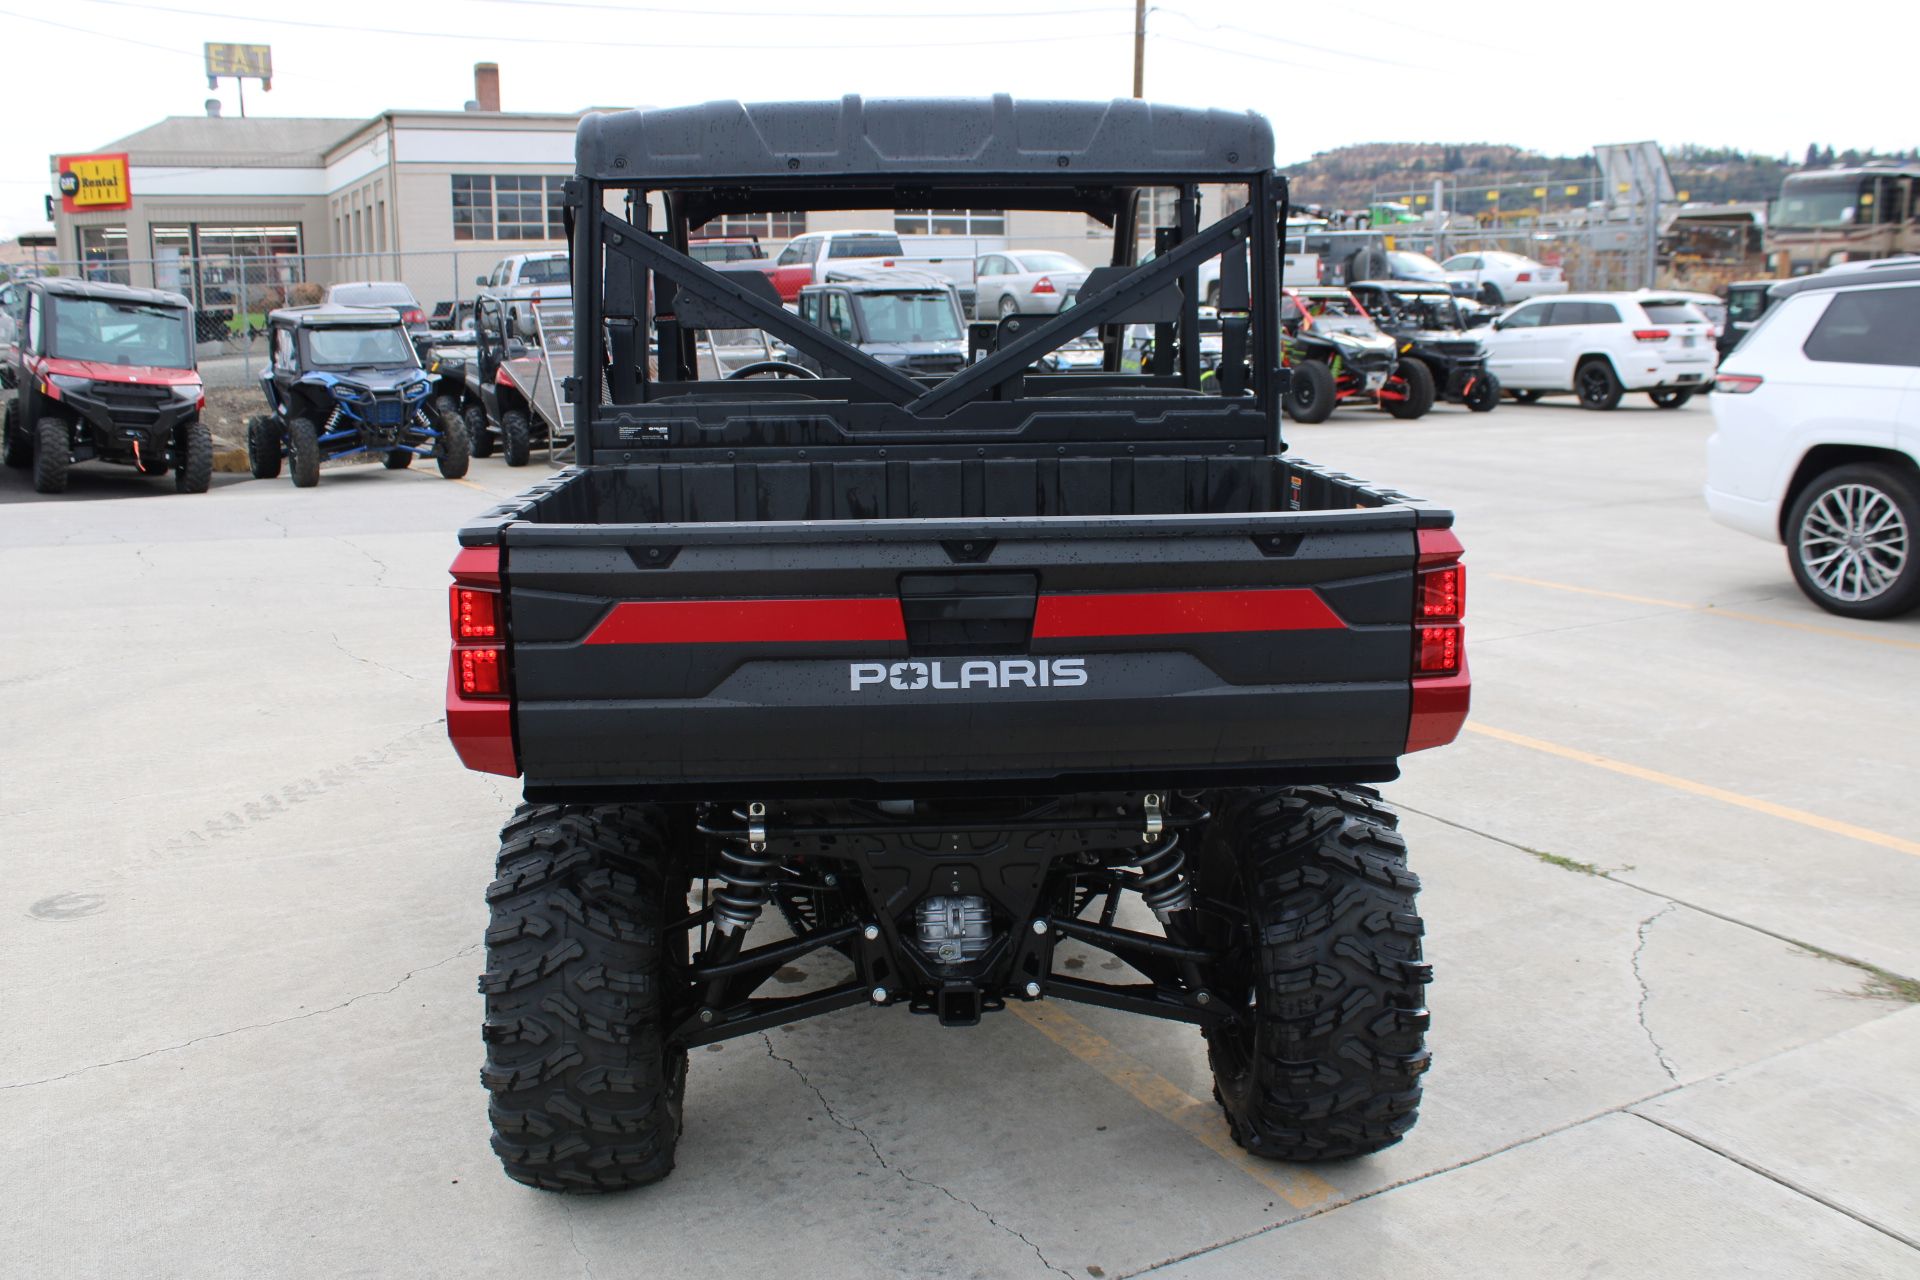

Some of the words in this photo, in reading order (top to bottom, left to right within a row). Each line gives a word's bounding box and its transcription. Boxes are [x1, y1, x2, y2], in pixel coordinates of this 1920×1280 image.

[208, 44, 268, 74] EAT
[81, 175, 118, 188] Rental
[850, 658, 1088, 691] POLARIS
